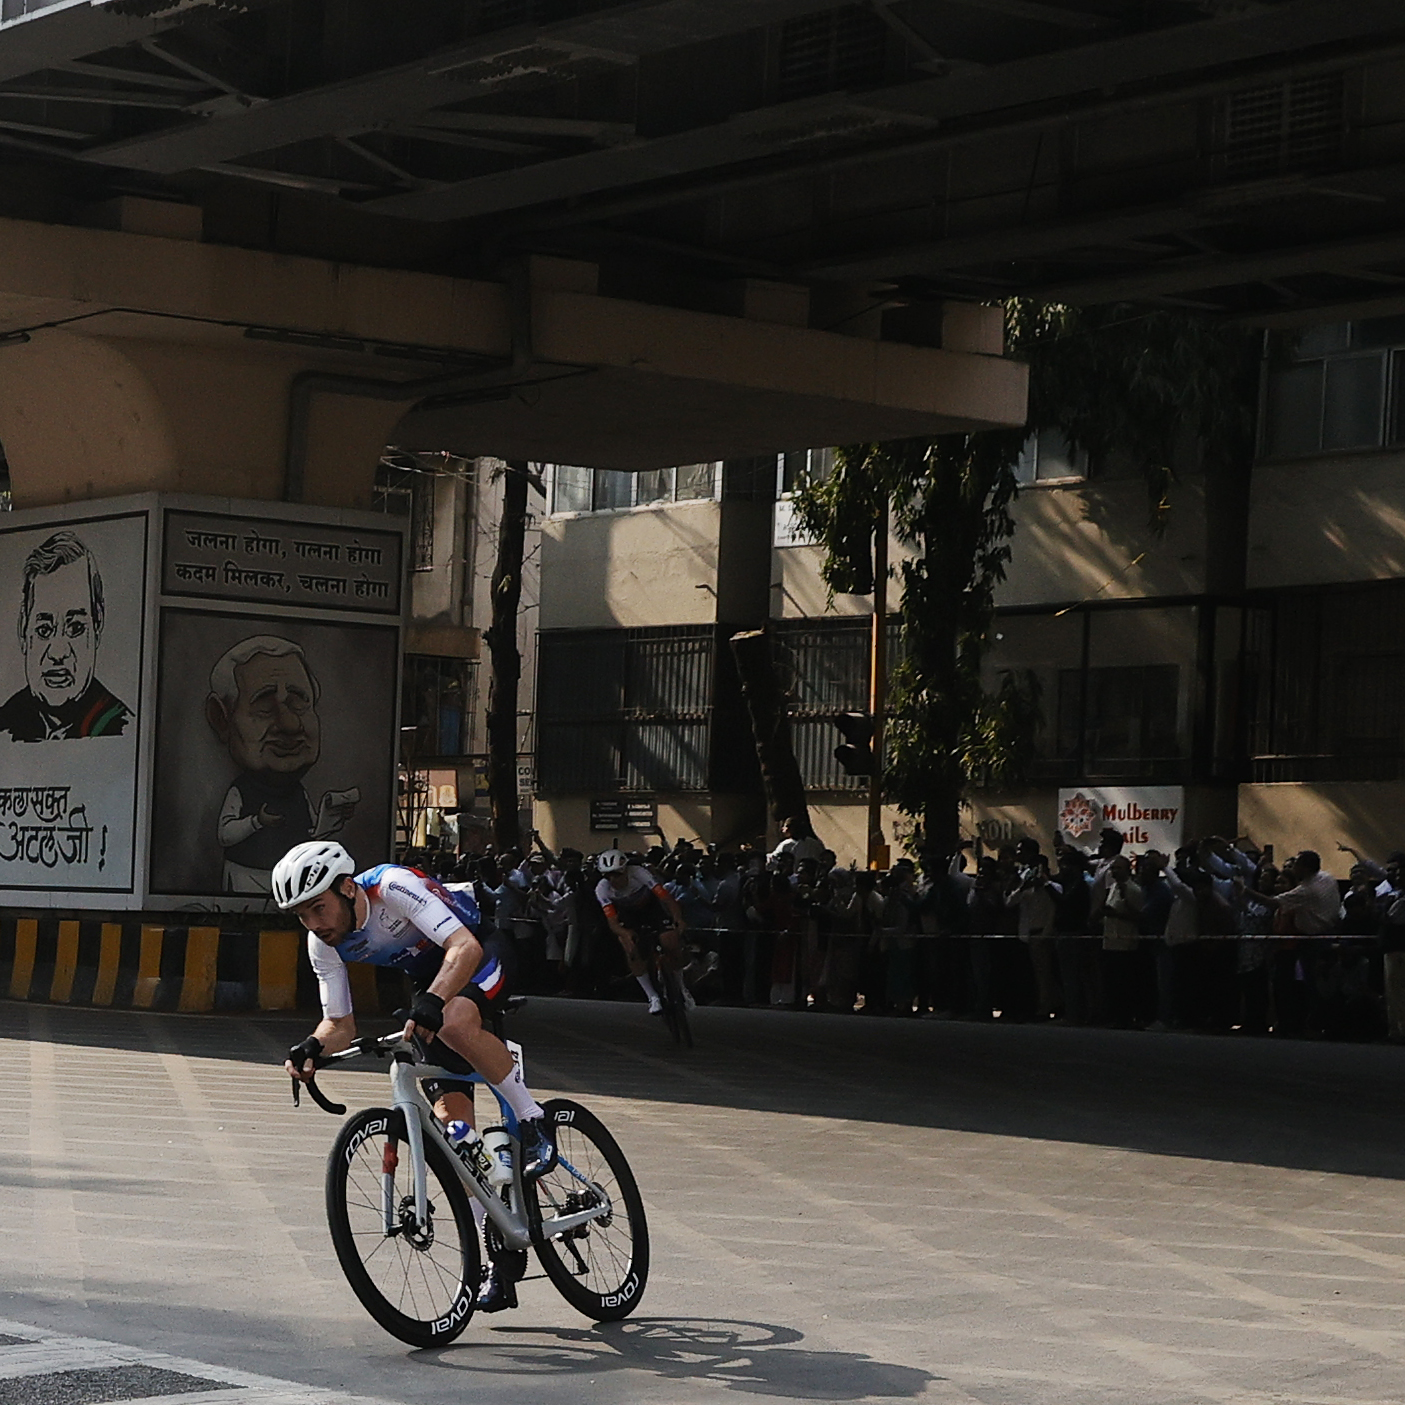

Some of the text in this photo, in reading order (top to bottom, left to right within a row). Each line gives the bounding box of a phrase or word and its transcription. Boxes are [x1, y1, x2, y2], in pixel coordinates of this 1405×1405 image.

[184, 528, 382, 566] जलना होगा, गलना होगा
[174, 558, 390, 598] कदम मिलकर, चलना होगा
[1121, 826, 1150, 844] ails
[344, 1117, 389, 1165] roval
[600, 1271, 640, 1308] roval
[430, 1284, 474, 1335] roval
